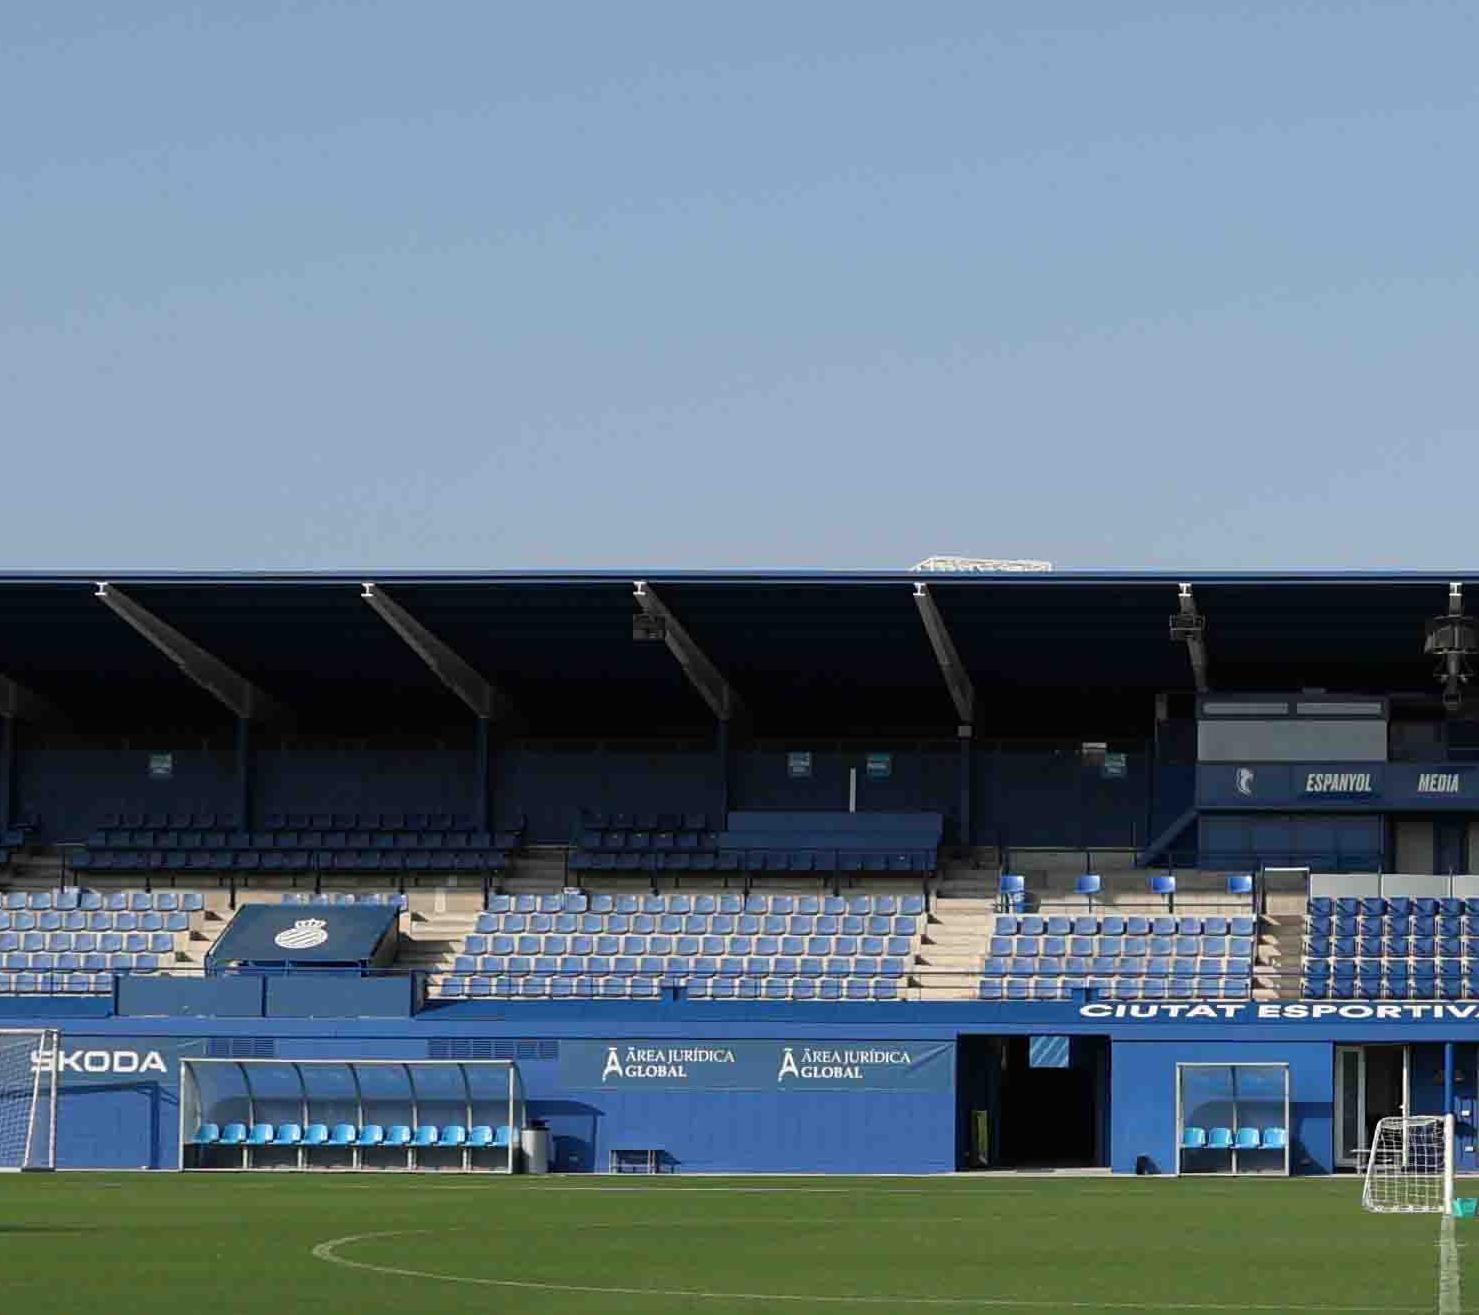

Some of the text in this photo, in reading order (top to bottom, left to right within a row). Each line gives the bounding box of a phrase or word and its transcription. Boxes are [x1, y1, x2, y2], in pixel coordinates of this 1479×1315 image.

[1305, 773, 1460, 793] ESPANYOL MEDIA
[1079, 1004, 1246, 1018] CIUTAT
[666, 1047, 735, 1065] JURÍDICA
[842, 1048, 911, 1066] JURÍDICA
[624, 1065, 687, 1078] GLOBAL
[800, 1066, 863, 1079] GLOBAL
